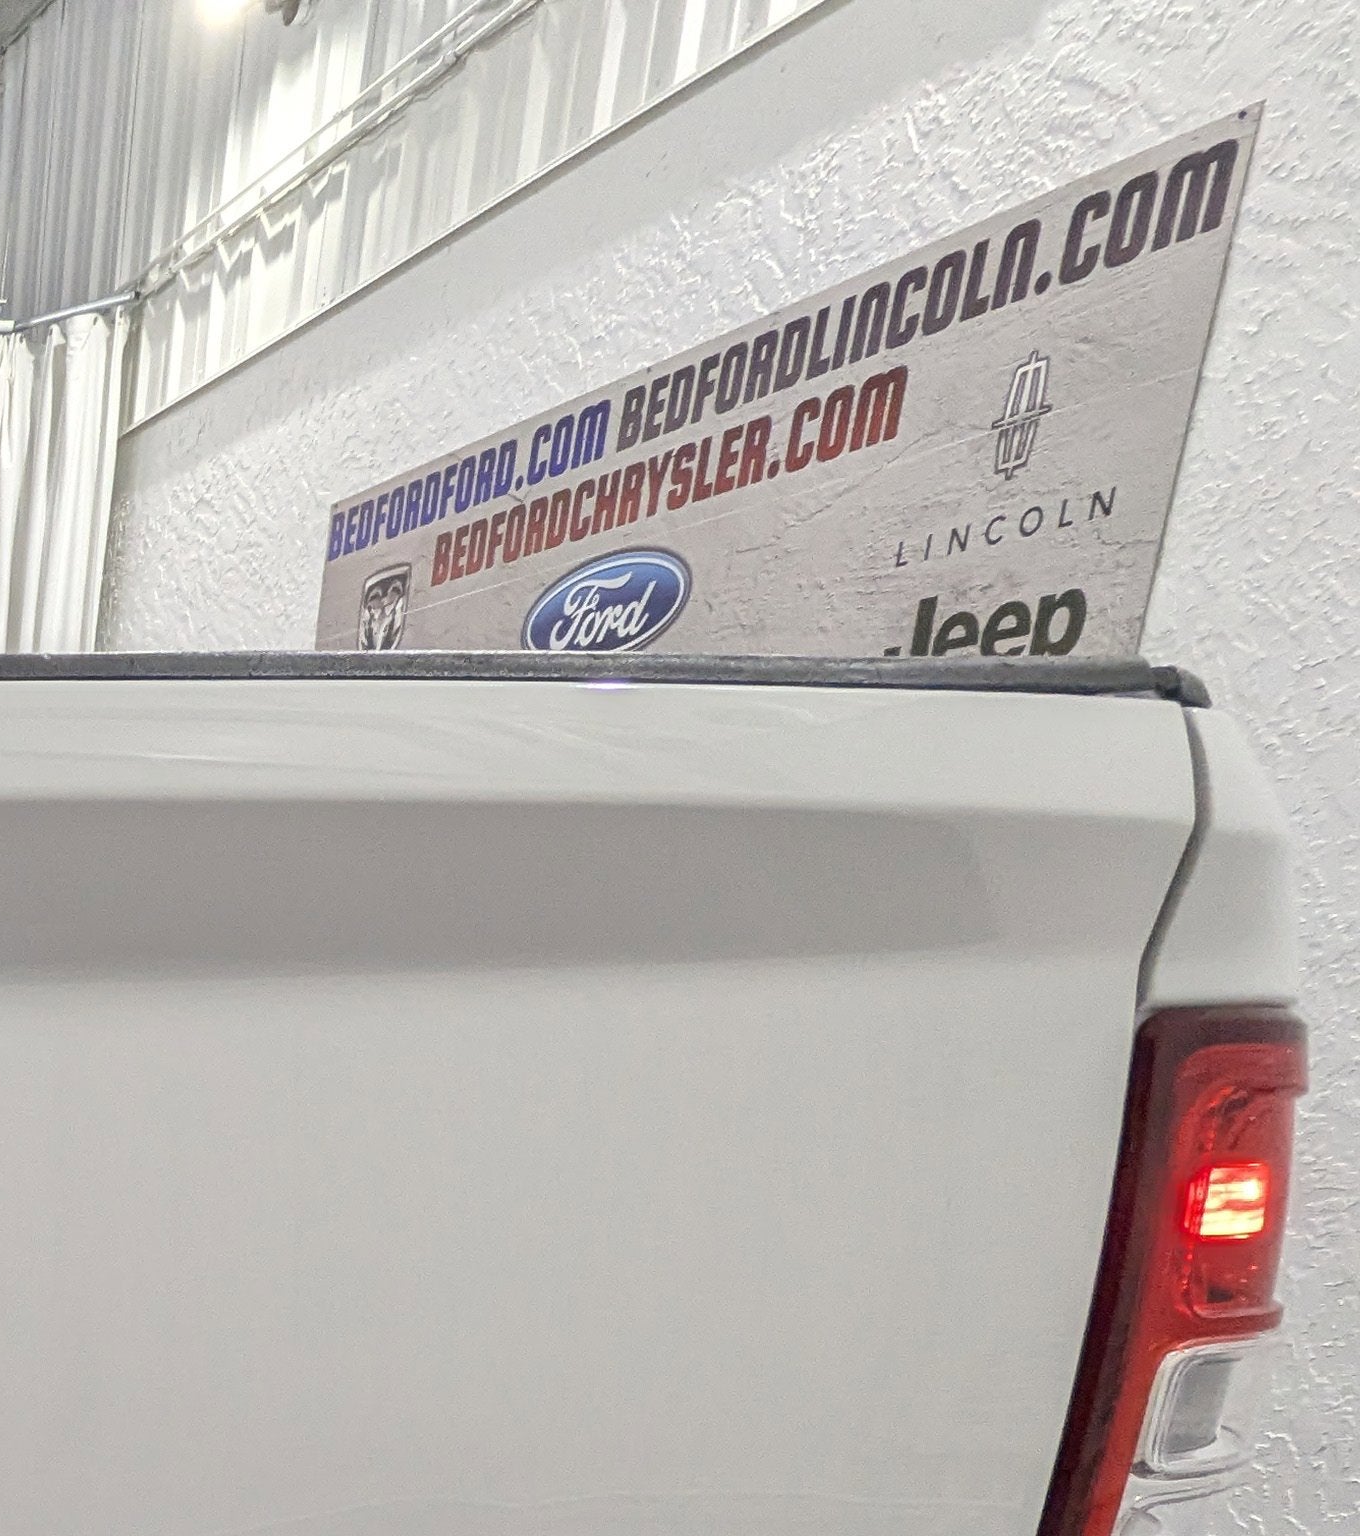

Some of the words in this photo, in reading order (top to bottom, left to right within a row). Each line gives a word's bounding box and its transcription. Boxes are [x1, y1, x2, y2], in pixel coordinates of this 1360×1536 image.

[327, 399, 611, 562] BEDFORDFORD.COM
[615, 138, 1240, 453] BEDFORDLINCOLN.COM
[429, 365, 909, 587] BEDFORDCHRYSLER.COM
[894, 486, 1117, 568] LINCOLN
[548, 571, 659, 651] Ford
